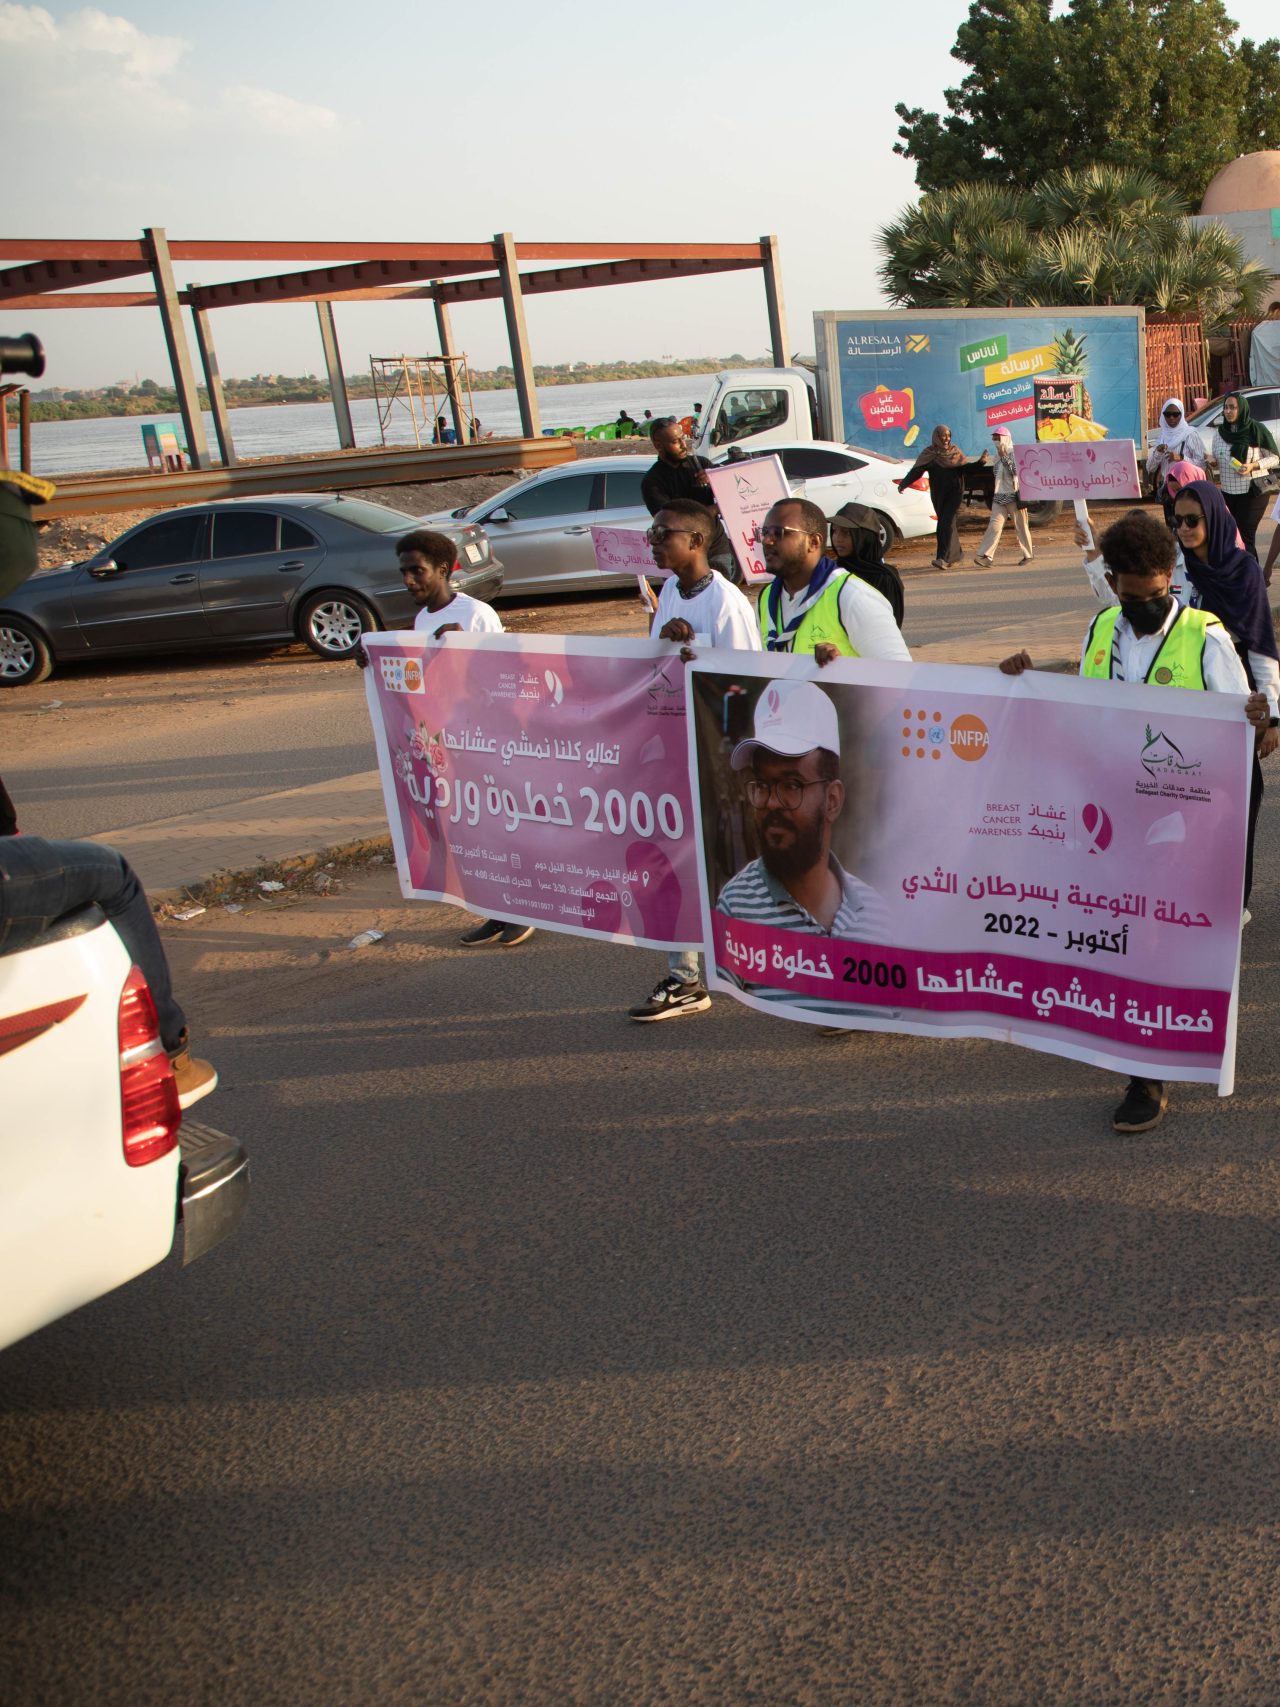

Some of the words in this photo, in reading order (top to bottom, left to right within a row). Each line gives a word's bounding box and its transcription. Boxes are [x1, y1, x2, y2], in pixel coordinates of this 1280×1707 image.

[847, 346, 902, 356] الرسالة
[848, 335, 901, 345] ALRESALA
[1000, 354, 1044, 375] الرسالة
[880, 416, 894, 426] سي
[442, 727, 496, 754] عشانها
[501, 730, 551, 766] نمشي
[554, 738, 581, 761] كلنا
[949, 730, 990, 747] UNFPA
[586, 743, 620, 768] تعالو
[405, 761, 480, 825] وردية
[484, 774, 574, 832] خطوة
[986, 803, 1020, 812] BREAST
[579, 785, 684, 840] 2000
[983, 815, 1021, 824] CANCER
[968, 827, 1022, 836] AWARENESS
[902, 866, 958, 899] الثدي
[966, 875, 1059, 909] بسرطان
[1067, 884, 1147, 918] التوعية
[1153, 899, 1212, 927] حملة
[984, 912, 1040, 939] 2022
[1064, 924, 1129, 955] أكتوبر
[725, 930, 767, 972] وردية
[772, 943, 835, 979] خطوة
[842, 957, 907, 989] 2000
[916, 962, 1024, 1000] عشانها
[1031, 976, 1116, 1019] نمشي
[1123, 998, 1214, 1036] فعالية
